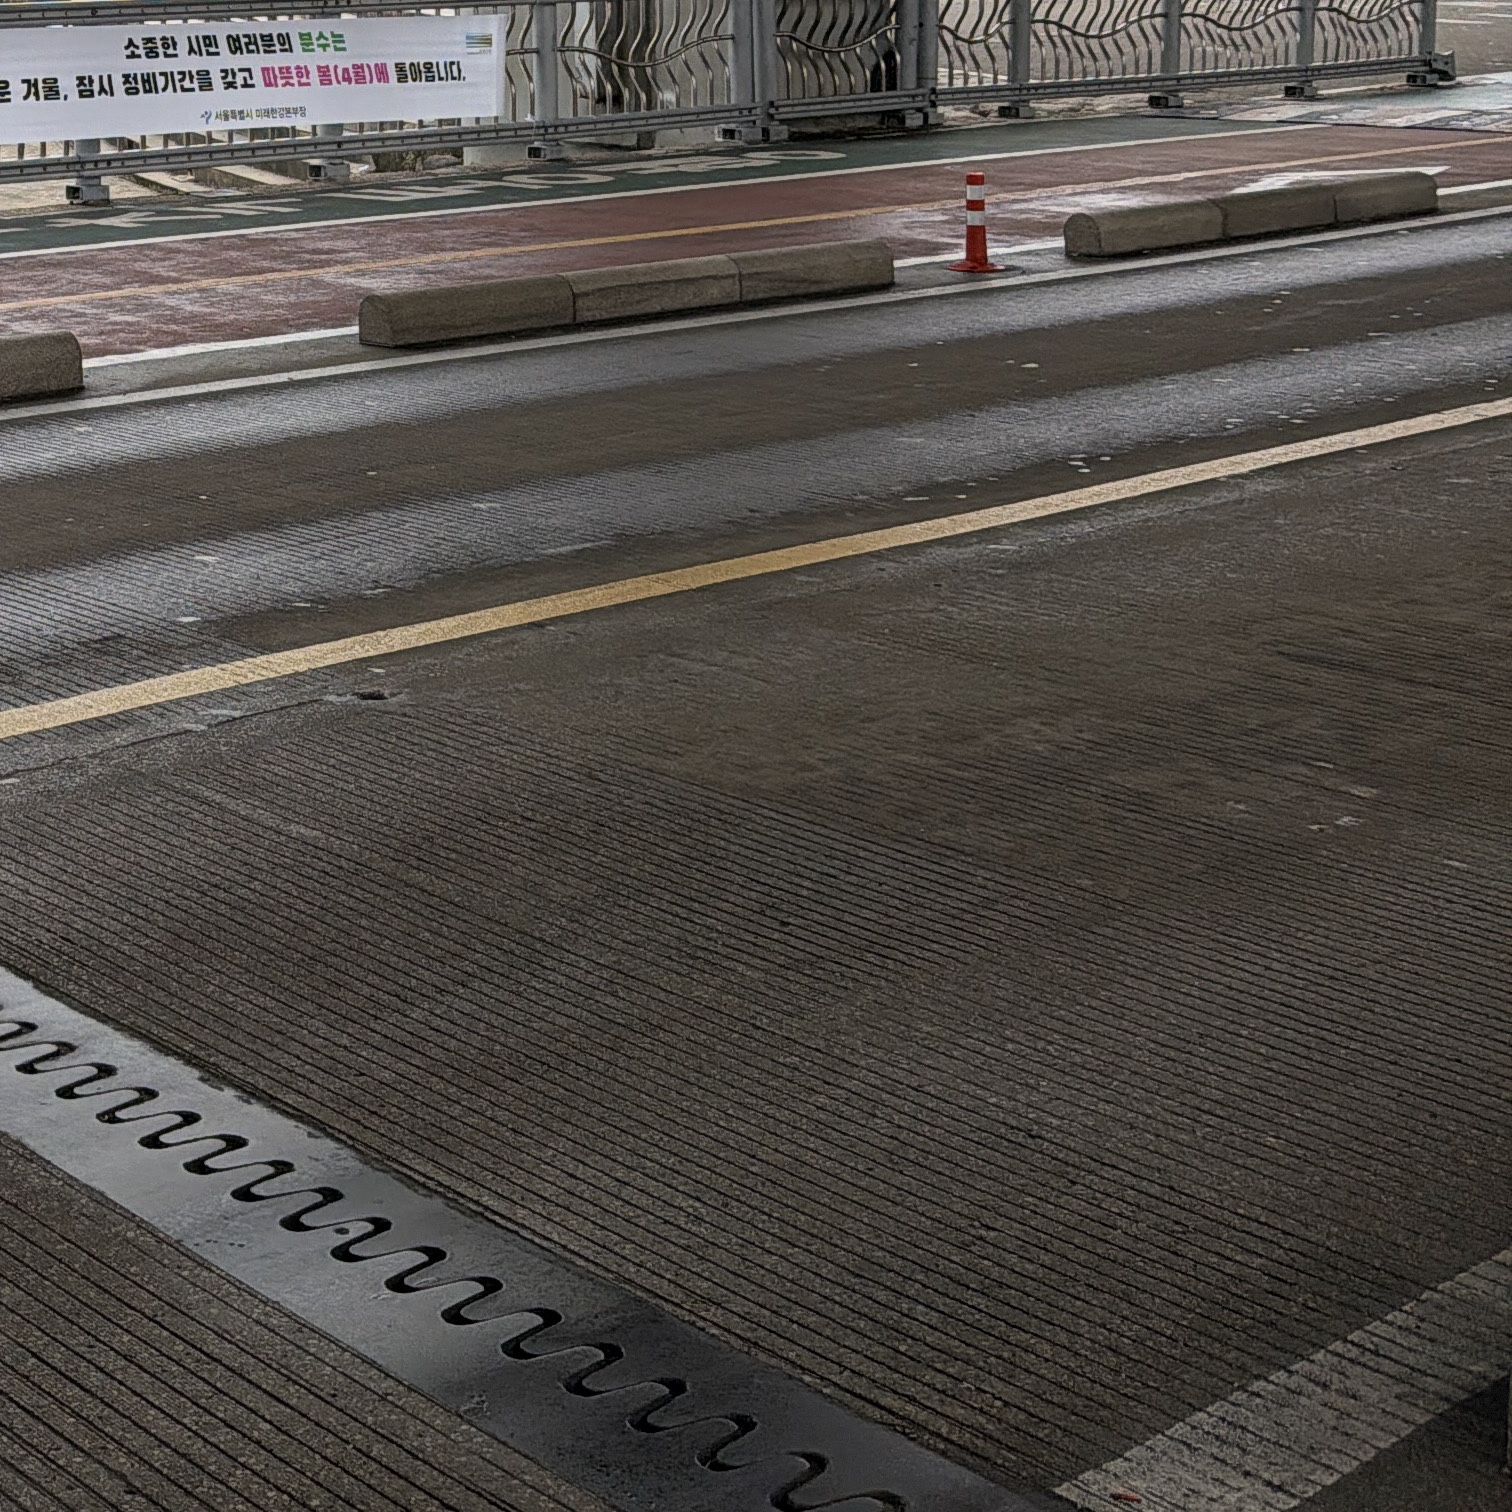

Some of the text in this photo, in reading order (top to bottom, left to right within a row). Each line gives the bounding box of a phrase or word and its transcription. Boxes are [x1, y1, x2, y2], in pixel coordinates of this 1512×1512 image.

[124, 30, 347, 59] 소중한 시민 여러분의 분수는
[21, 77, 68, 102] 겨울,
[75, 73, 115, 99] 잠시
[121, 69, 214, 96] 정비기간을
[219, 67, 255, 91] 갖고
[260, 64, 311, 88] 따뜻한
[316, 62, 390, 87] 봄(4월)에
[394, 60, 467, 84] 돌아옵니다.
[214, 105, 308, 123] 서울특별시 미래한강본부장
